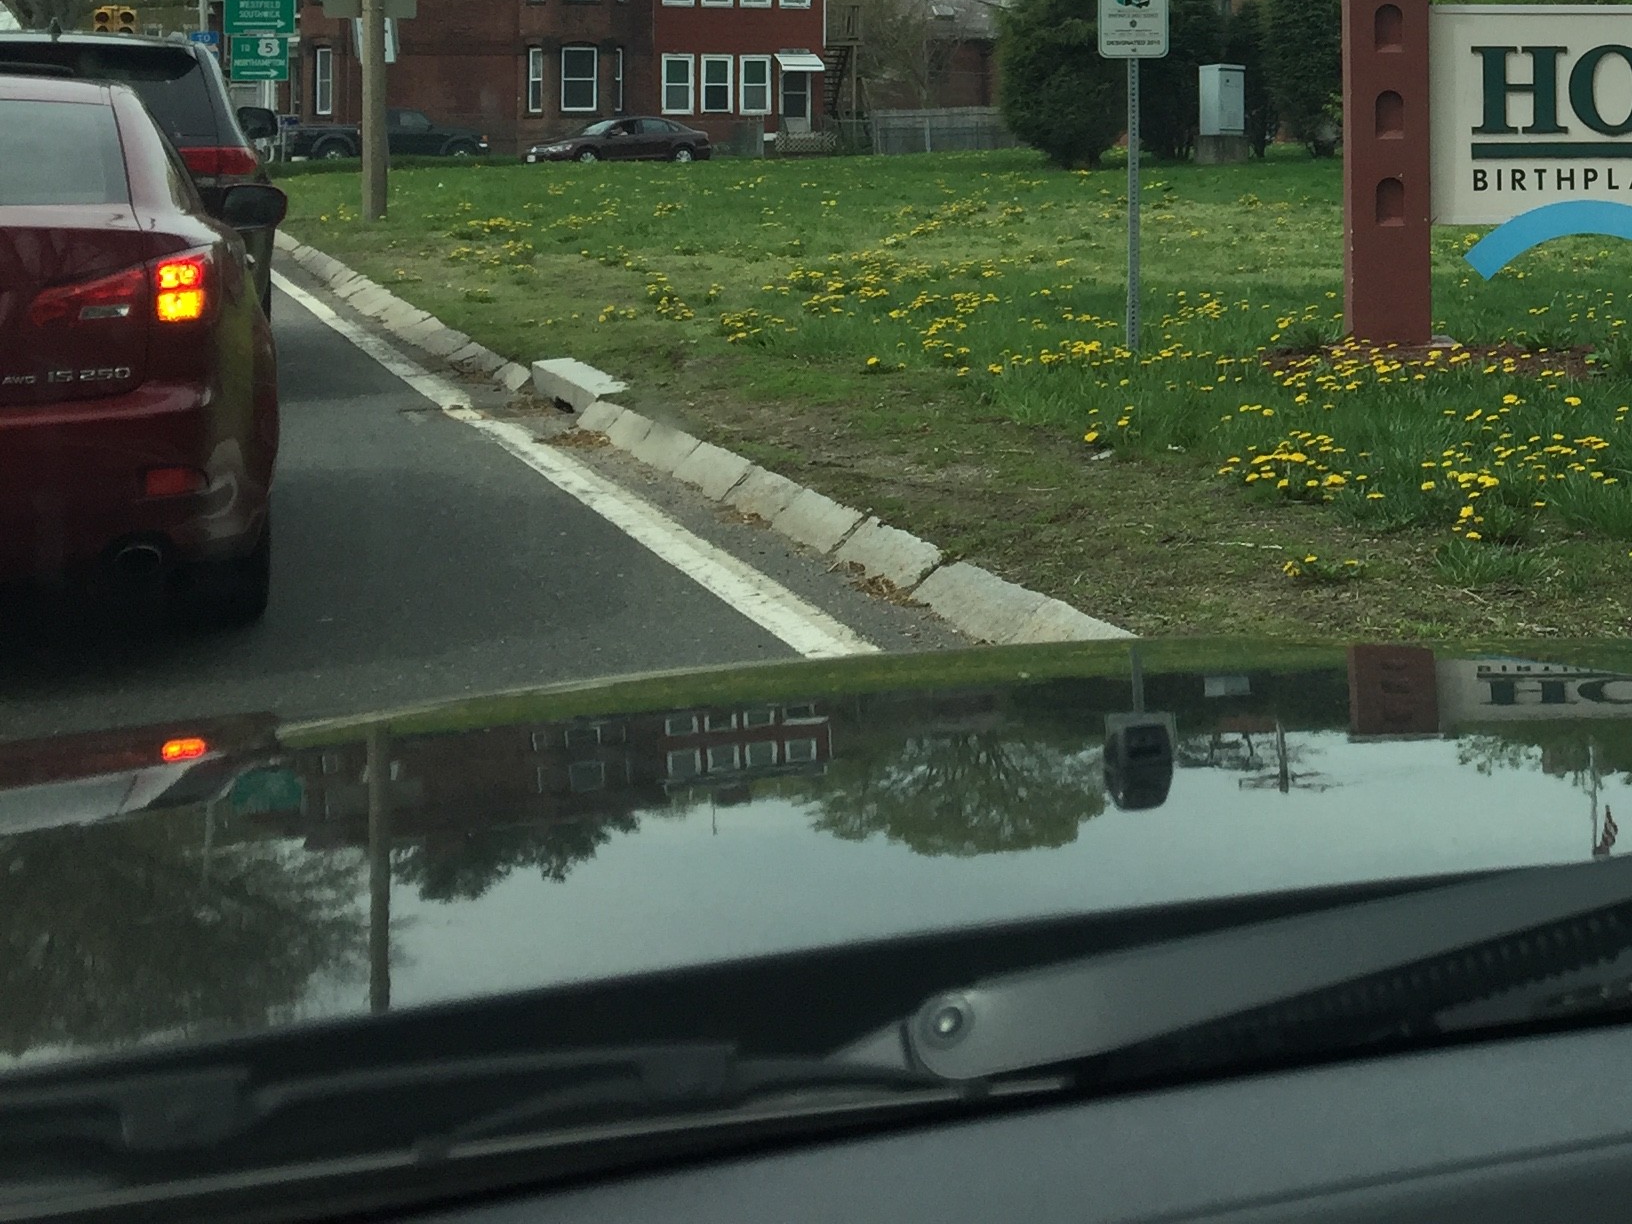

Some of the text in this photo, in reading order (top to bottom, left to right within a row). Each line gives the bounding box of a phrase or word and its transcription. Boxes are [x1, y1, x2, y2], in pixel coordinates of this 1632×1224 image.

[239, 0, 281, 9] WESTFIELD
[241, 42, 274, 54] TO 5
[233, 58, 286, 67] NORTHAMPTON
[48, 370, 73, 382] IS
[79, 367, 131, 381] 250
